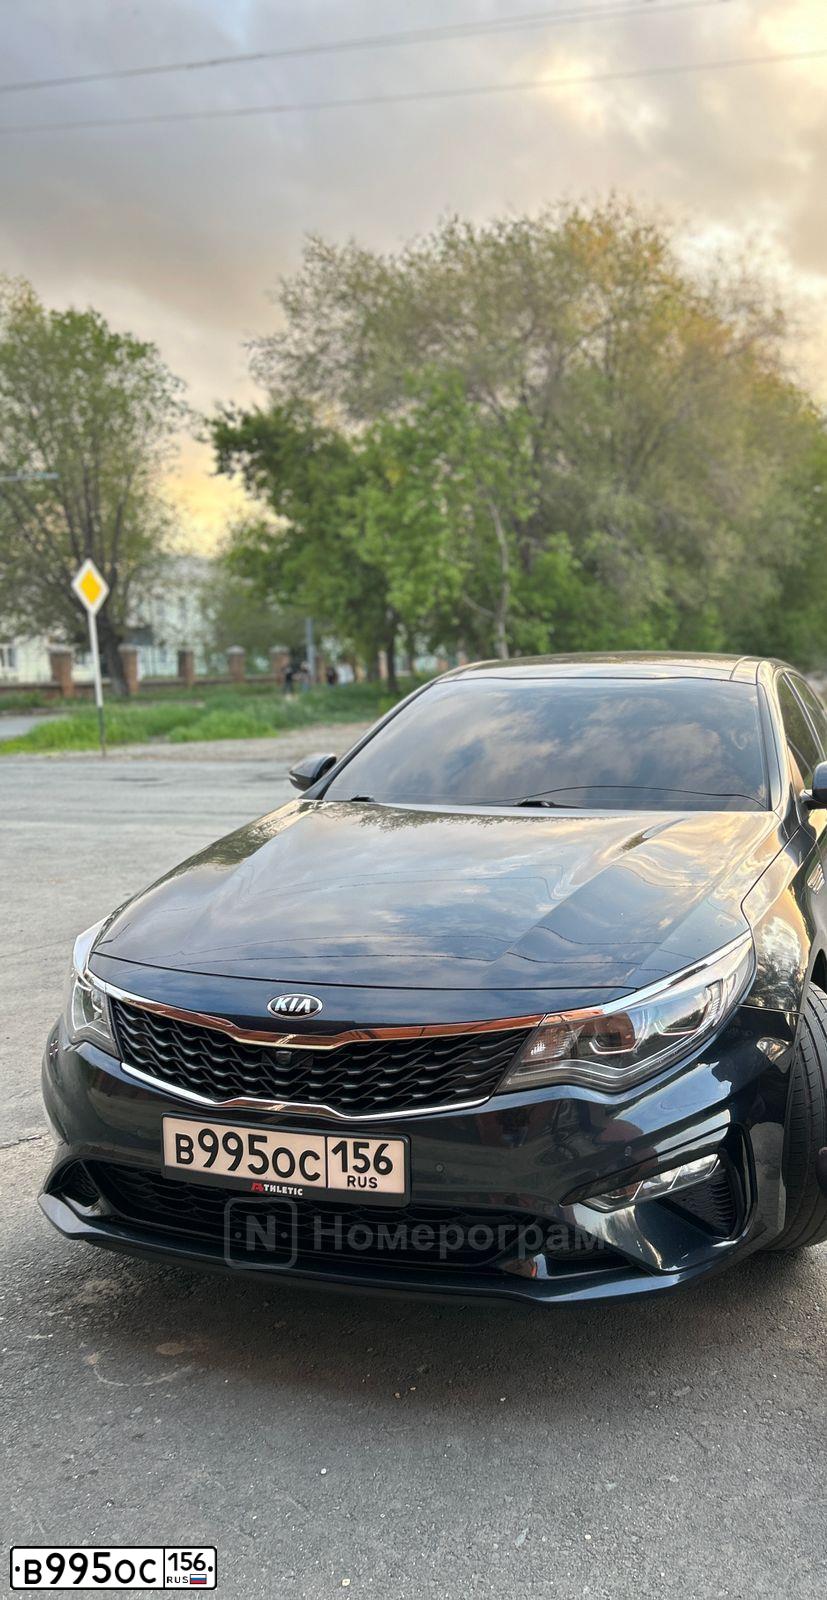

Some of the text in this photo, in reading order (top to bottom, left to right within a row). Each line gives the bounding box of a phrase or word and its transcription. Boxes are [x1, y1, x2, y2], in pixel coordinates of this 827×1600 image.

[274, 997, 312, 1013] KIA
[175, 1128, 394, 1182] В995ОС 156
[346, 1175, 379, 1189] RUS
